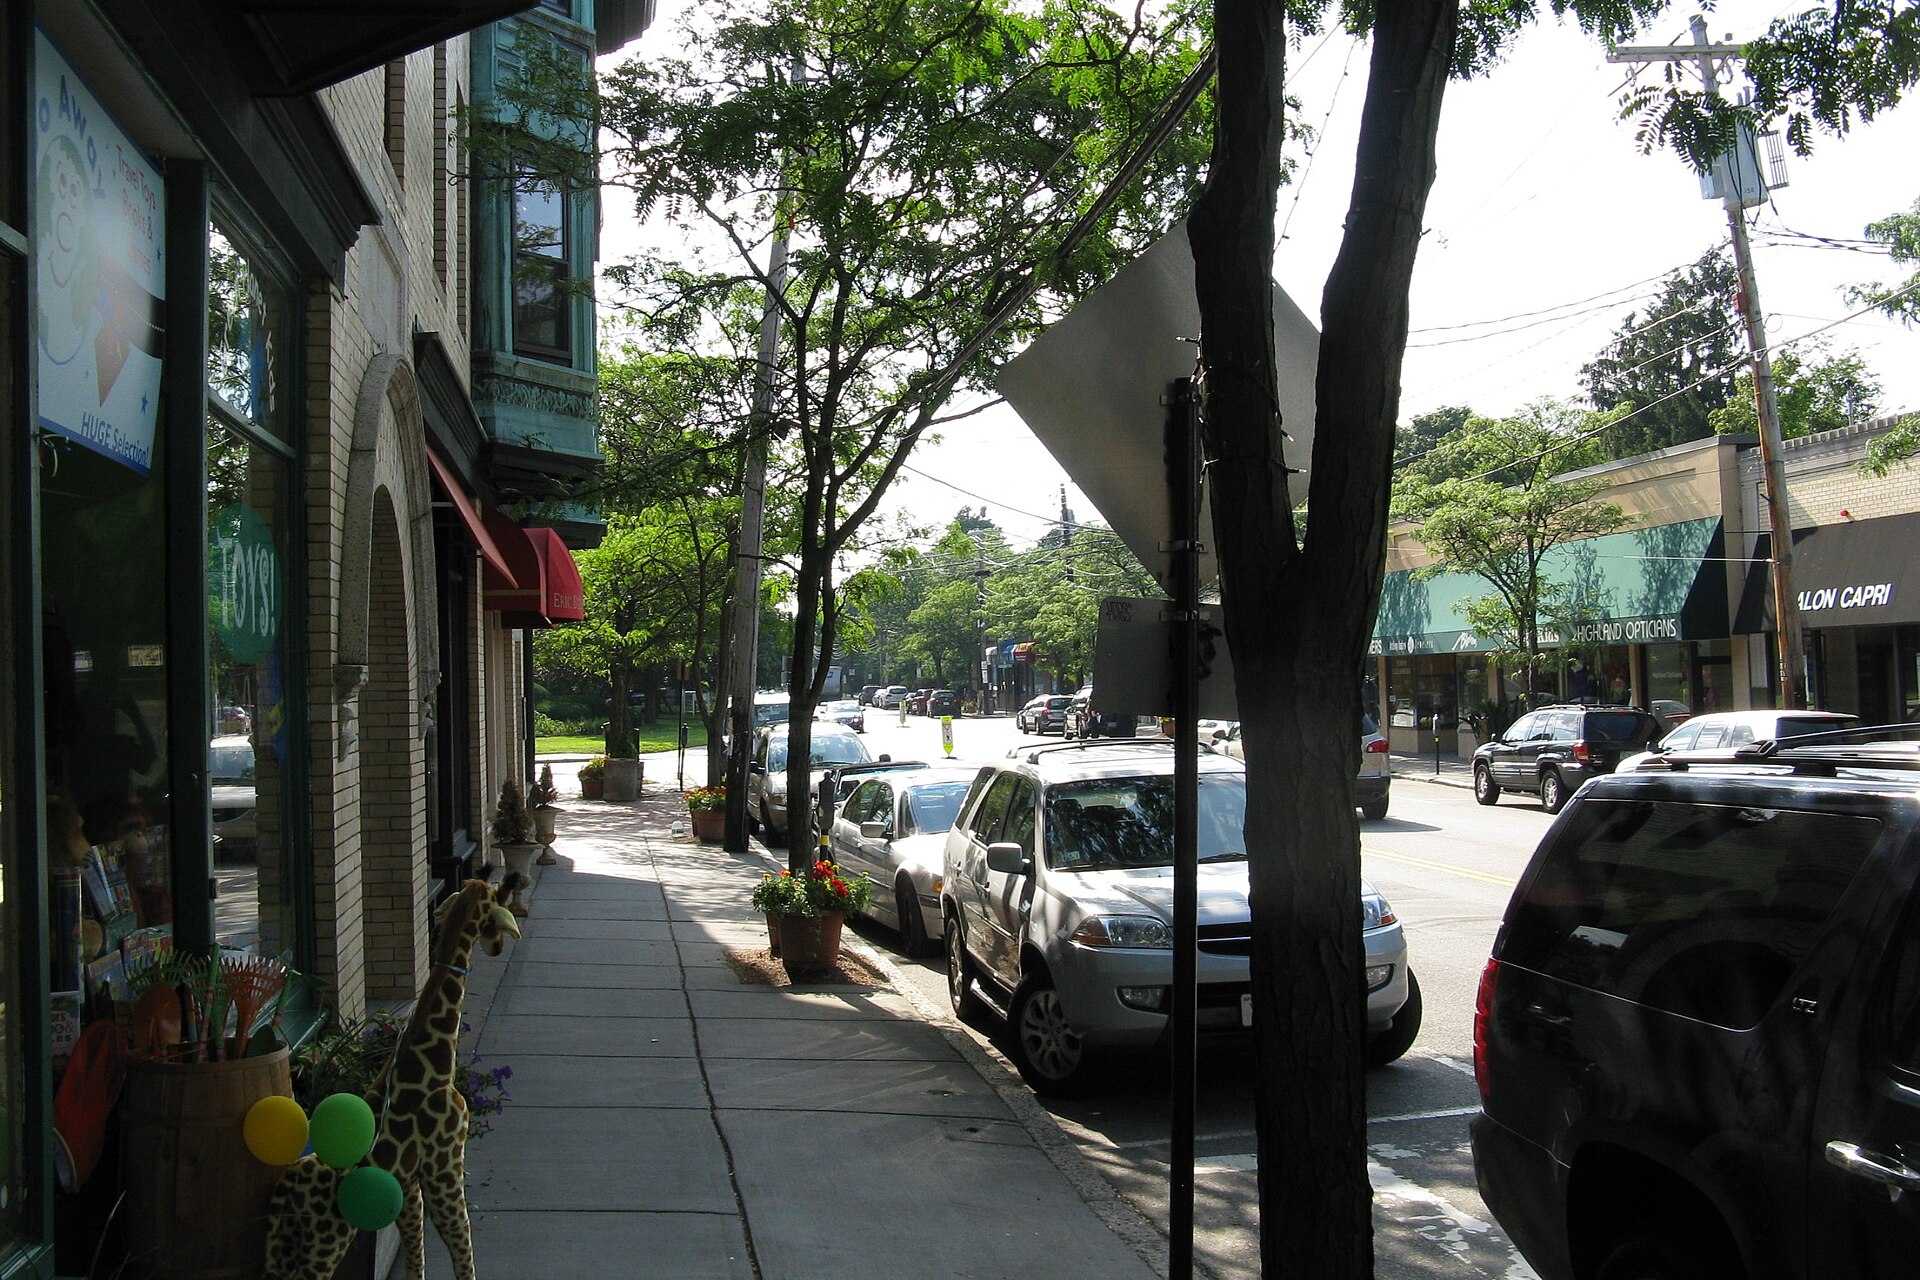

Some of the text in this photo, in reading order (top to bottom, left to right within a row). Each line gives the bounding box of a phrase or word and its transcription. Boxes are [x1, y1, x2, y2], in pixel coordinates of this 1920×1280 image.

[80, 411, 150, 466] HUGE Selection!
[216, 526, 275, 637] TOYS!
[1797, 583, 1892, 611] ALON CAPRI
[1577, 618, 1677, 642] HIGHLAND OPTICIANS
[1367, 639, 1383, 655] ERS
[1792, 997, 1818, 1013] LTZ
